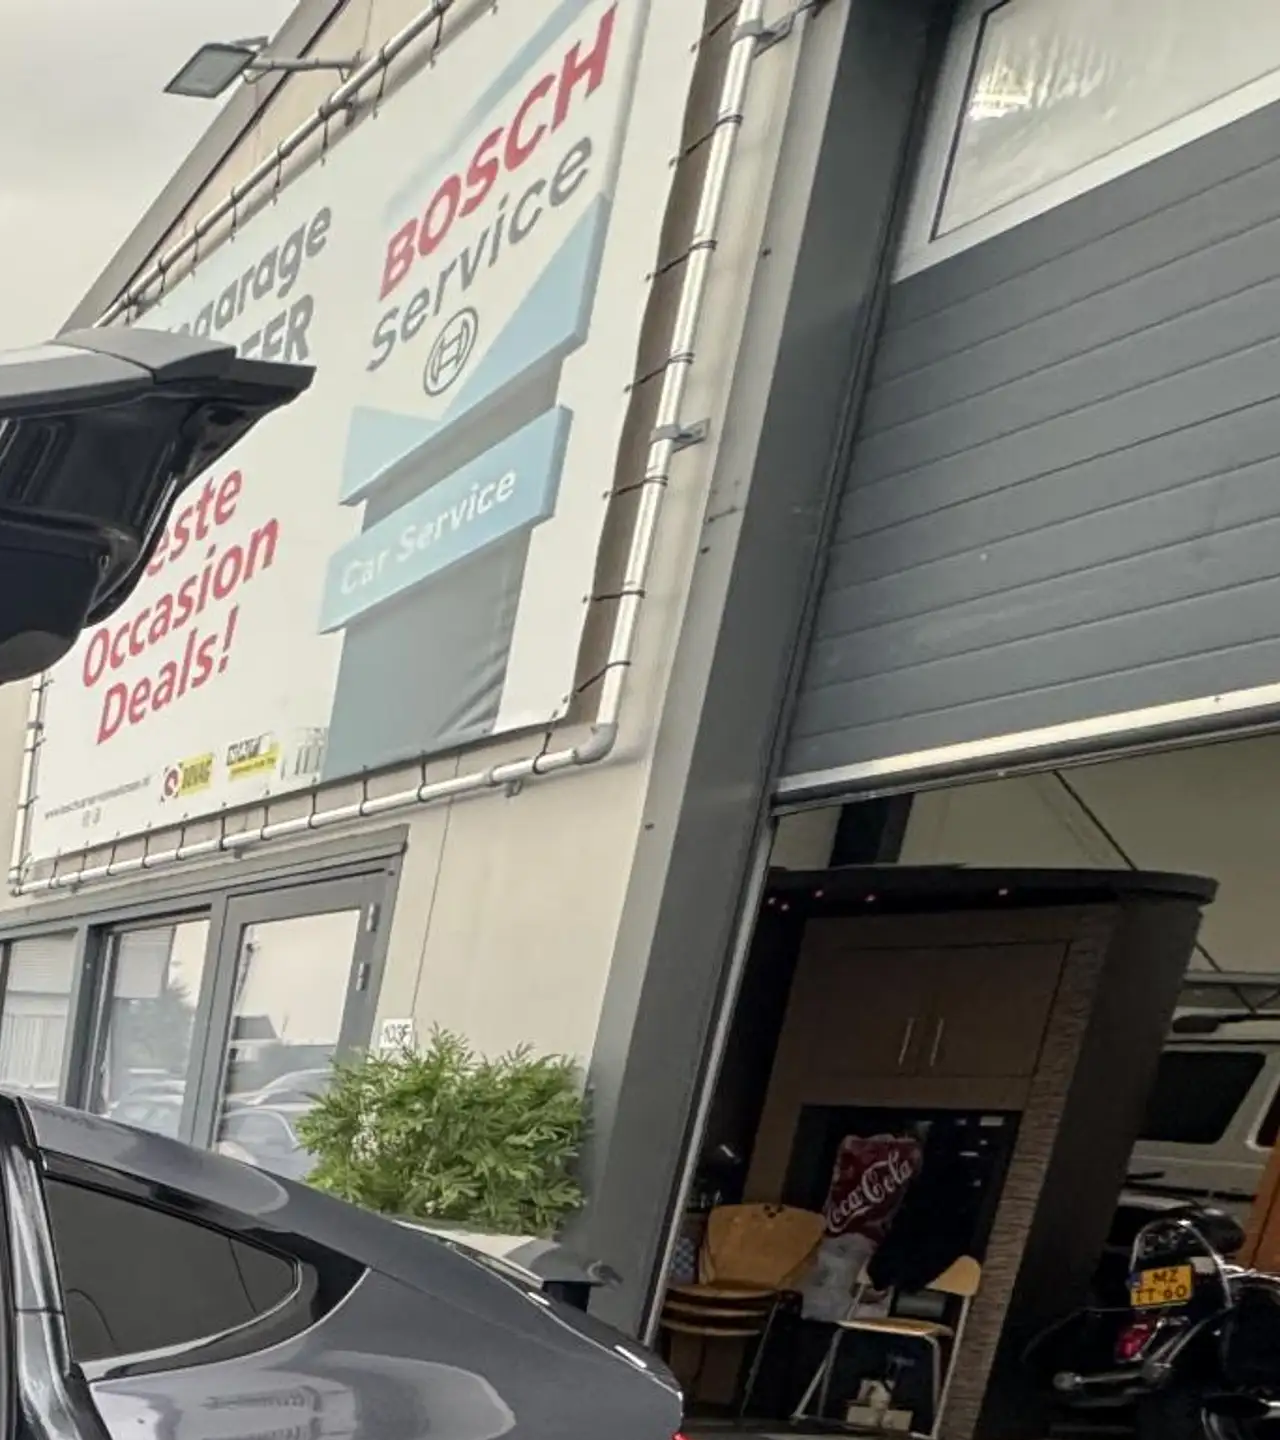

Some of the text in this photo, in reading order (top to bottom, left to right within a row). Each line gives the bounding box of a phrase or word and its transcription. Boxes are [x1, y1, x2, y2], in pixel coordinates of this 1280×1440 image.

[379, 1, 619, 302] BOSCH
[170, 206, 332, 338] garage
[145, 469, 242, 577] este
[341, 468, 517, 595] Car Service
[82, 517, 279, 688] Occasion
[96, 602, 240, 746] Deals!
